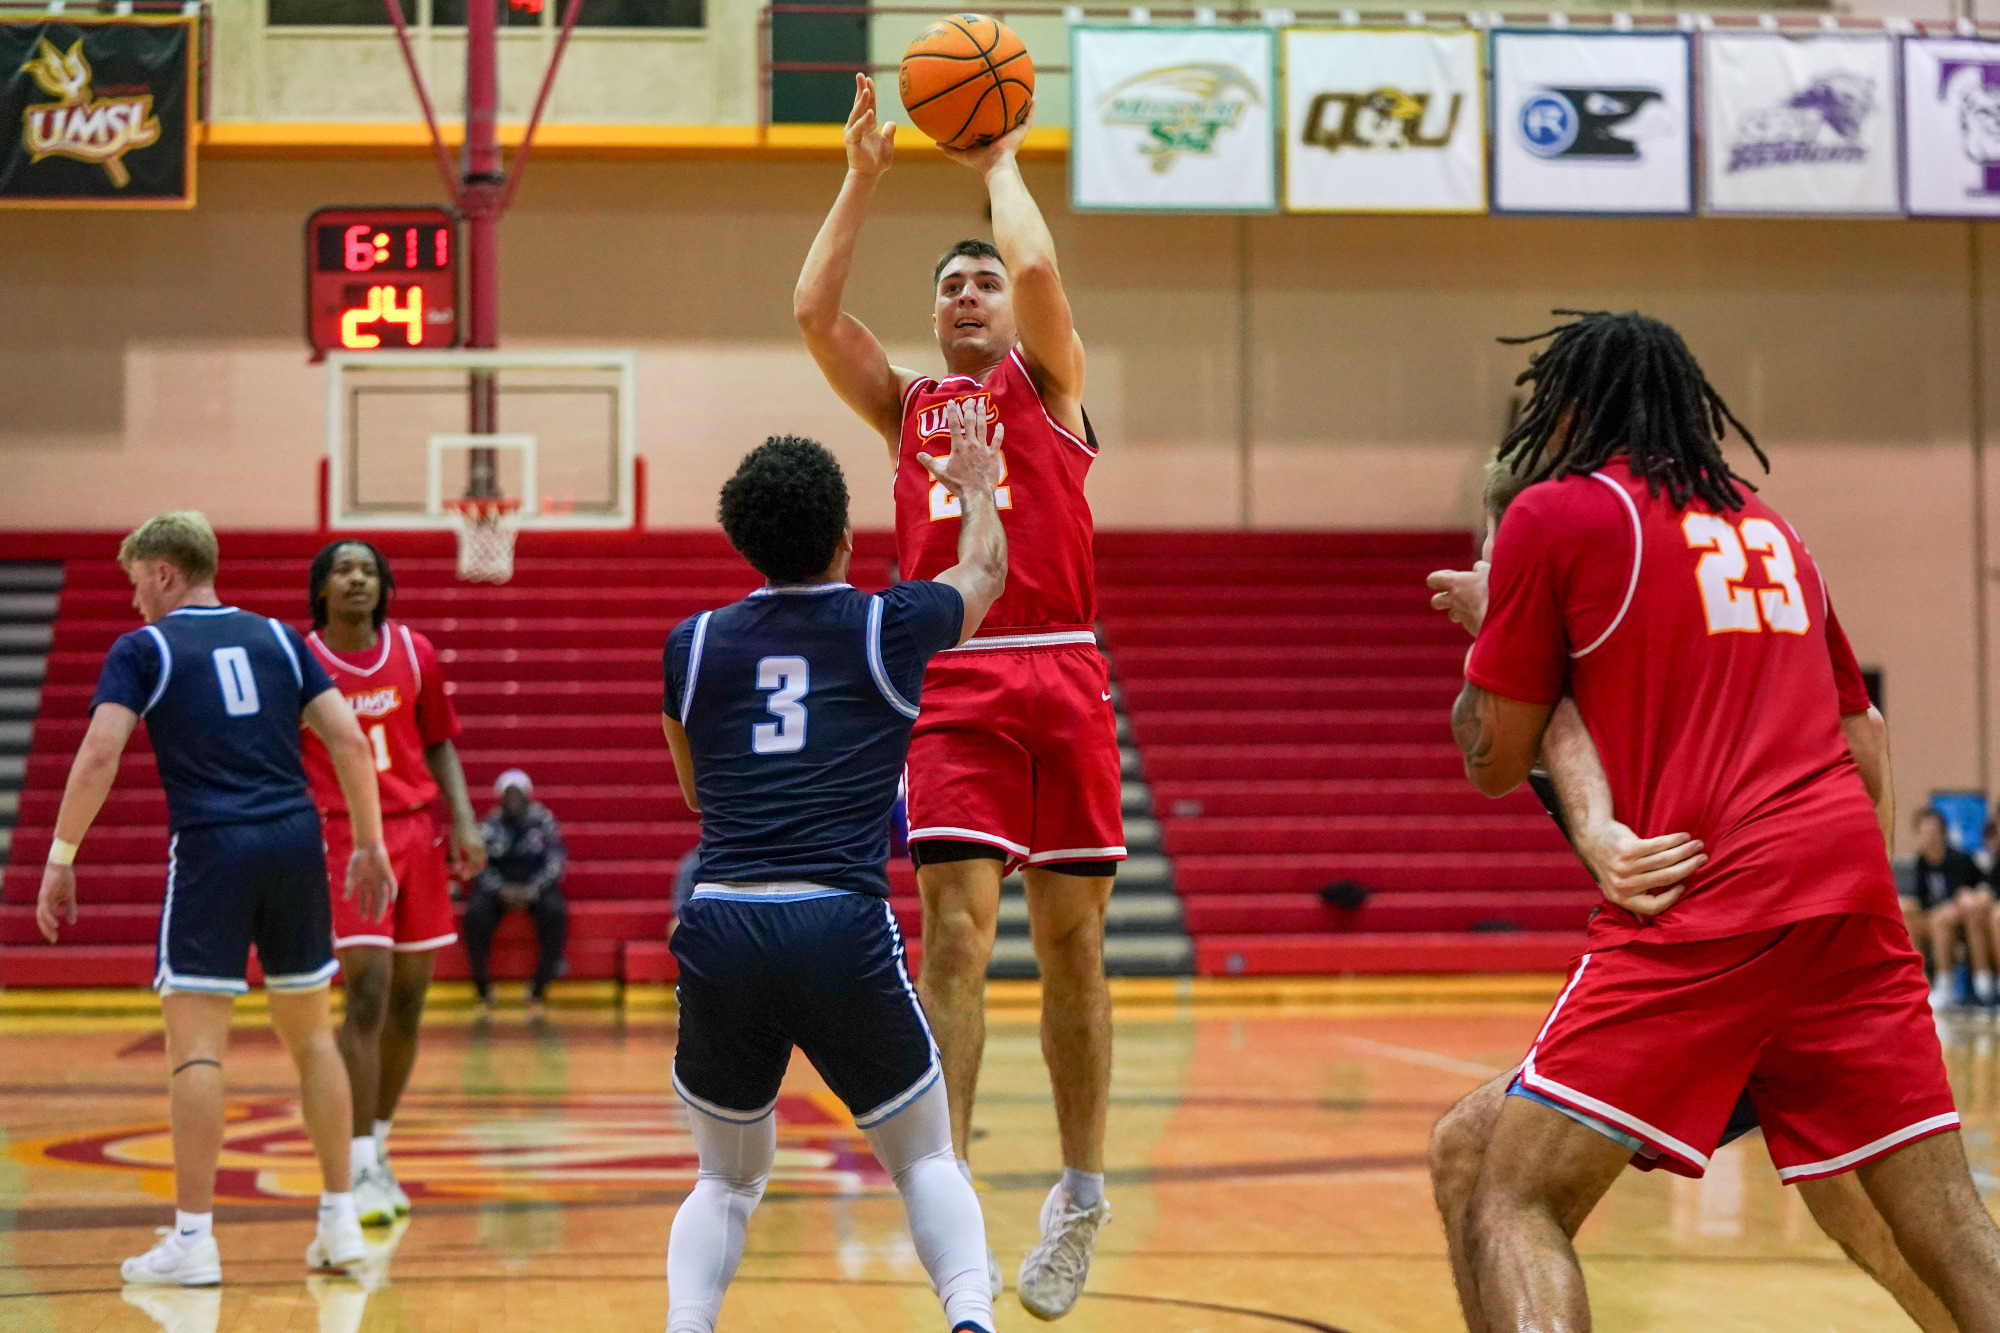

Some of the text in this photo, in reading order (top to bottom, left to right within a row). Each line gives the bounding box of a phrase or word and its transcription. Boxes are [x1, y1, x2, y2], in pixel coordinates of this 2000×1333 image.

[28, 99, 158, 157] UMSL
[344, 224, 448, 272] 6:11
[341, 285, 423, 349] 24
[1681, 511, 1811, 636] 23
[212, 645, 261, 717] 0
[752, 655, 810, 755] 3
